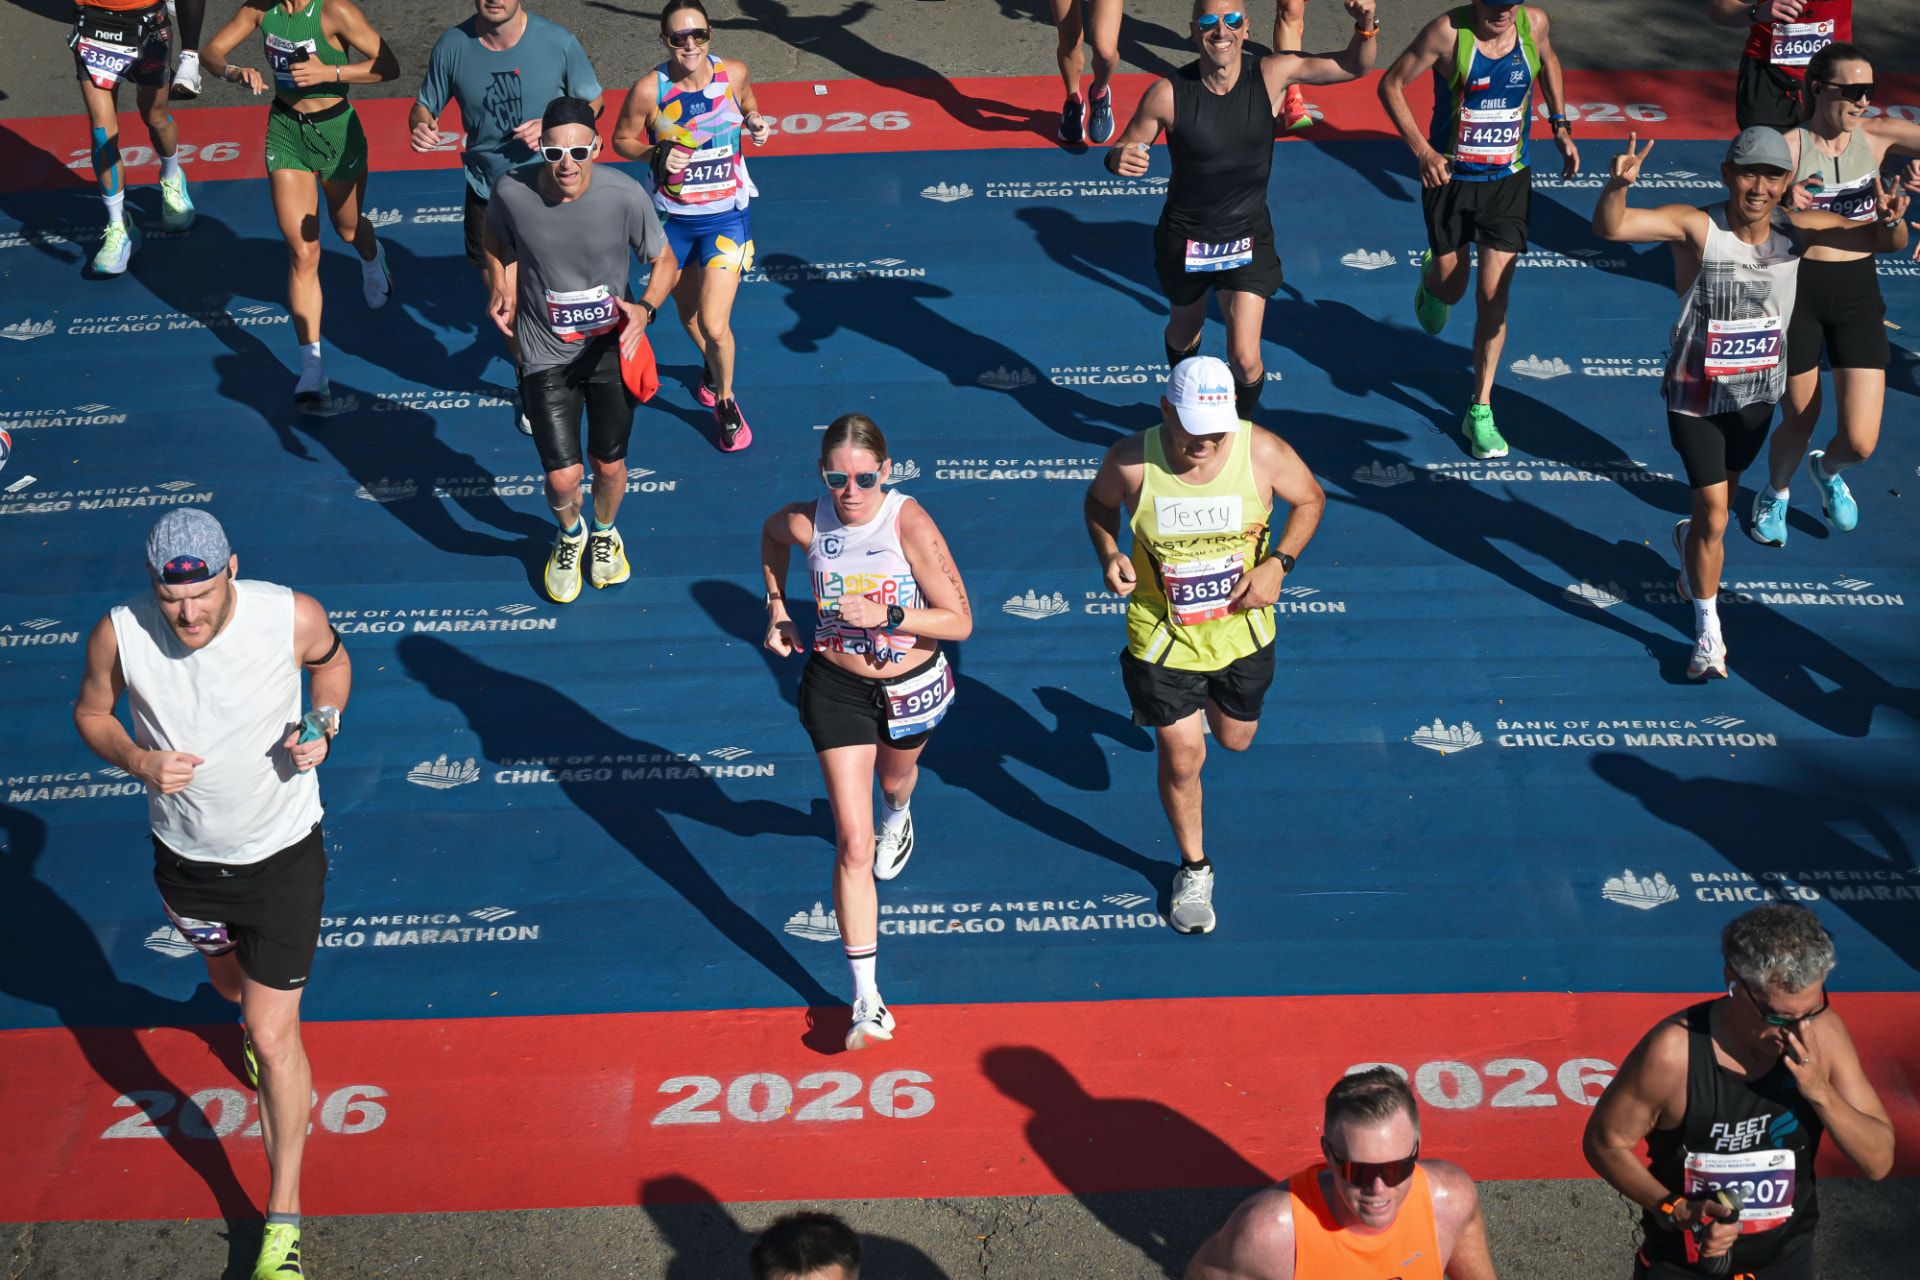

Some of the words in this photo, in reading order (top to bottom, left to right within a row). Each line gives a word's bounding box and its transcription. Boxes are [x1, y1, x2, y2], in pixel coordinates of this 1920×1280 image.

[95, 30, 123, 42] nerd
[1481, 98, 1507, 109] CHILE
[1531, 102, 1668, 122] 026
[741, 110, 911, 136] 2026
[1463, 126, 1521, 143] F44294
[684, 162, 732, 182] 34747
[1531, 180, 1603, 188] HICAGO
[1628, 180, 1724, 189] ARATHON
[986, 188, 1073, 198] CHICAGO
[1080, 186, 1168, 196] MARATH
[413, 213, 464, 223] CHIC
[806, 268, 925, 281] MARATHON
[1876, 267, 1920, 276] CHIC
[552, 302, 613, 324] F38697
[67, 321, 160, 335] CHICAGO
[168, 315, 290, 331] MARATHON
[1711, 337, 1778, 355] D22547
[1584, 366, 1665, 377] CHICAG
[1051, 374, 1148, 385] CHICAGO
[377, 391, 426, 399] BANK
[372, 399, 470, 411] CHICAGO
[0, 409, 67, 418] MERICA
[936, 459, 990, 467] BANK
[1023, 457, 1101, 466] AMERIC
[935, 468, 1038, 481] CHICAGO
[1429, 470, 1533, 482] CHICAGO
[1540, 470, 1674, 482] MARATHON
[1, 493, 29, 501] NK
[62, 486, 151, 498] AMERICA
[432, 485, 534, 498] CHICAGO
[77, 491, 214, 511] MARATHON
[1161, 503, 1230, 529] Jerry
[1152, 540, 1187, 550] AST
[1735, 581, 1830, 590] AMERICA
[1760, 592, 1905, 606] MARATHON
[329, 609, 352, 618] NK
[363, 609, 391, 618] OF
[394, 608, 489, 618] AMERICA
[1276, 601, 1346, 613] THON
[413, 617, 557, 633] MARATHON
[0, 631, 80, 648] ATHON
[1496, 718, 1557, 730] BANK
[1563, 720, 1590, 729] OF
[1597, 719, 1697, 729] AMERICA
[1500, 733, 1615, 747] CHICAGO
[1623, 733, 1777, 747] MARATHON
[500, 756, 561, 766] BANK
[567, 755, 595, 764] OF
[600, 752, 702, 764] AMERICA
[494, 767, 612, 784] CHICAGO
[621, 763, 776, 782] MARATHON
[8, 782, 147, 803] MARATHO
[1690, 872, 1756, 882] BANK
[1762, 871, 1789, 881] OF
[1798, 870, 1905, 881] AMERICA
[1695, 885, 1821, 902] CHICAGO
[1829, 885, 1920, 901] MARAT
[880, 903, 945, 914] BANK
[952, 902, 982, 913] OF
[989, 900, 1098, 913] AMERICA
[352, 913, 461, 927] AMERICA
[879, 917, 1005, 935] CHICAGO
[373, 925, 540, 947] MARATHON
[650, 1069, 936, 1126] 2026
[1709, 1114, 1771, 1138] FLEET
[1715, 1130, 1766, 1152] FEET
